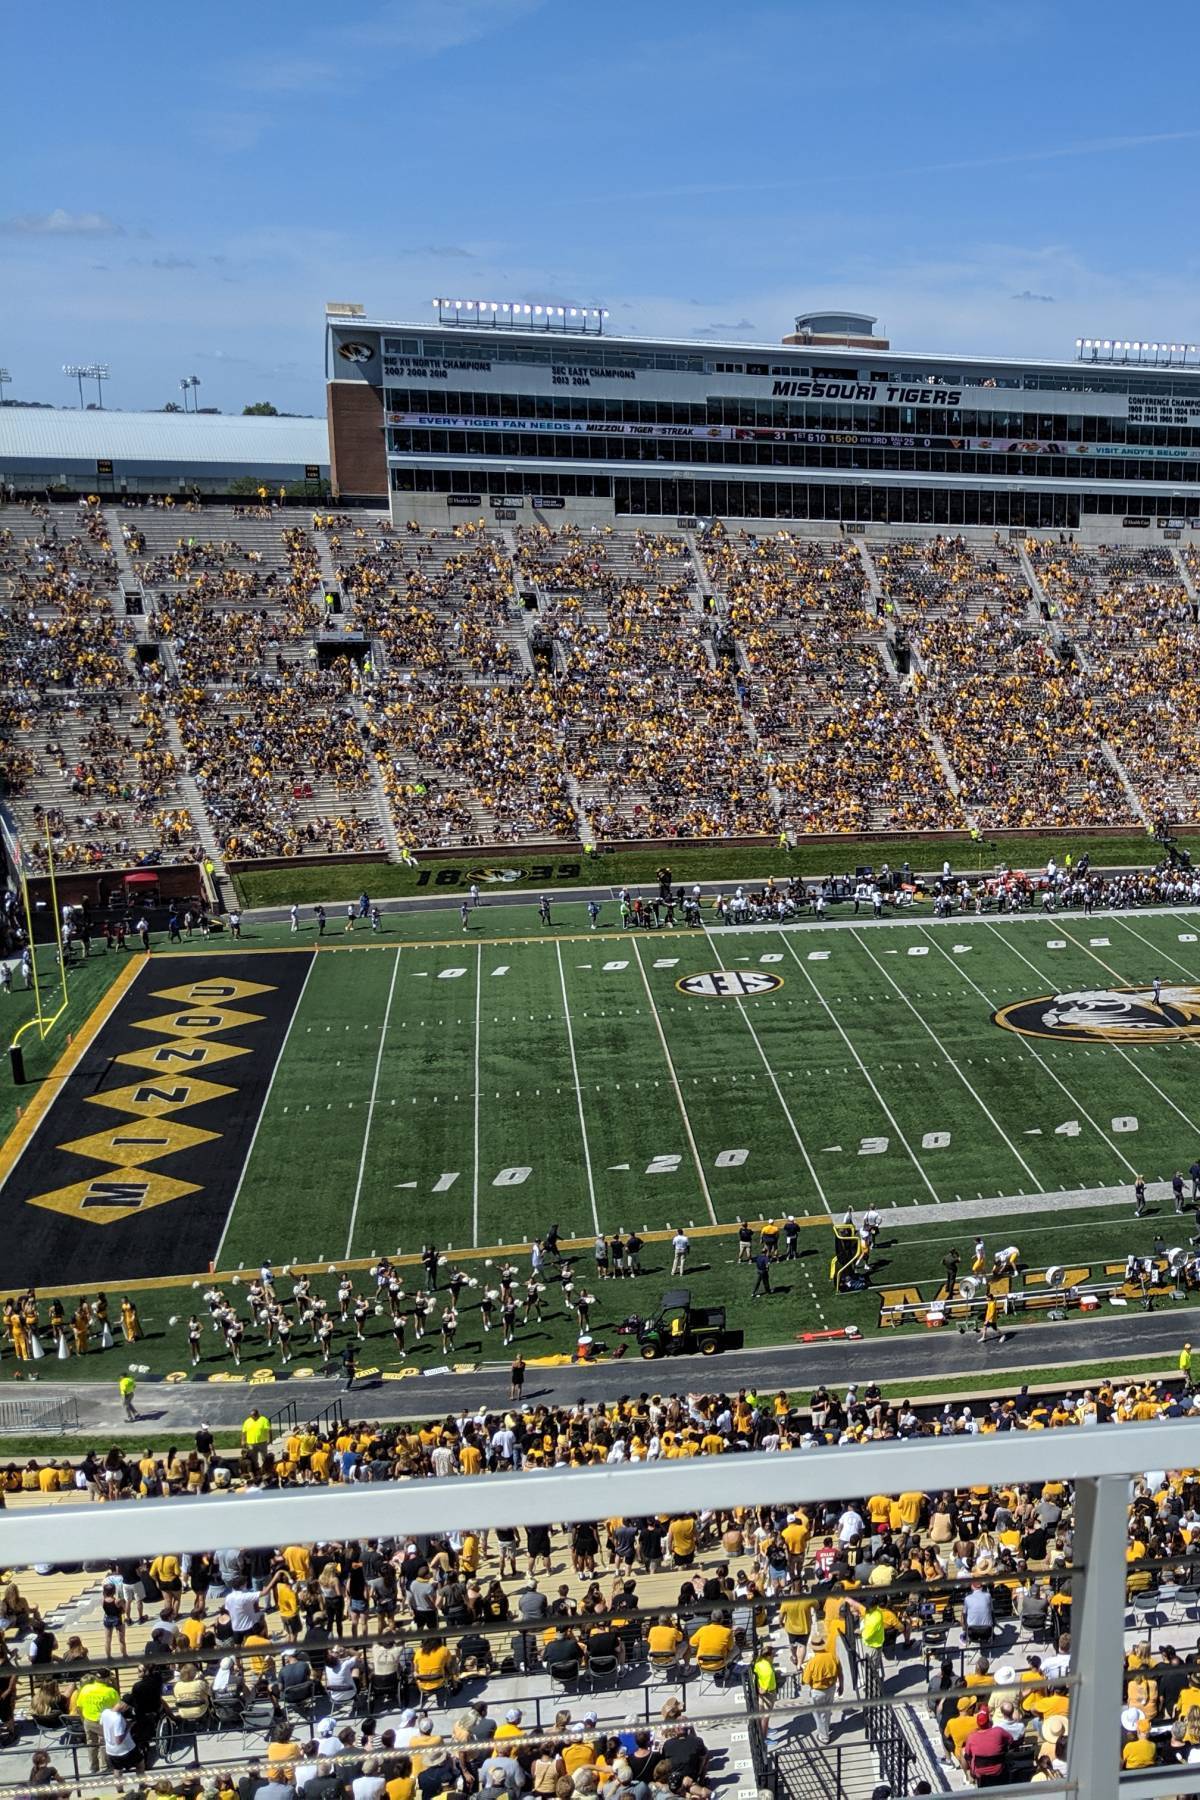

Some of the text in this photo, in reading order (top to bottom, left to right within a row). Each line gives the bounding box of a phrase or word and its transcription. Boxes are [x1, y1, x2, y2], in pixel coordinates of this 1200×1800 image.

[384, 356, 398, 366] BIG
[412, 358, 440, 369] NORTH
[442, 360, 491, 371] CHAMPIONS
[384, 367, 448, 378] 2007 2008 2010
[552, 366, 636, 379] SEC EAST CHAMPIONS
[552, 376, 590, 386] 2013 2014
[772, 381, 962, 405] MISSOURI TIGERS
[1128, 397, 1169, 406] CONFERENCE
[419, 416, 457, 425] EVERY
[464, 418, 501, 427] TIGER
[503, 420, 526, 429] FAN
[530, 421, 570, 430] NEEDS
[586, 424, 624, 432] MIZZOU
[629, 425, 653, 434] TIGER
[662, 427, 694, 435] STREAK
[774, 431, 786, 440] 31
[829, 435, 858, 443] 15:00
[872, 436, 887, 444] 3RD
[904, 438, 914, 446] 25
[924, 439, 931, 447] 0
[529, 864, 581, 881] 39
[686, 971, 774, 995] SEC
[80, 985, 239, 1210] MIZZOU
